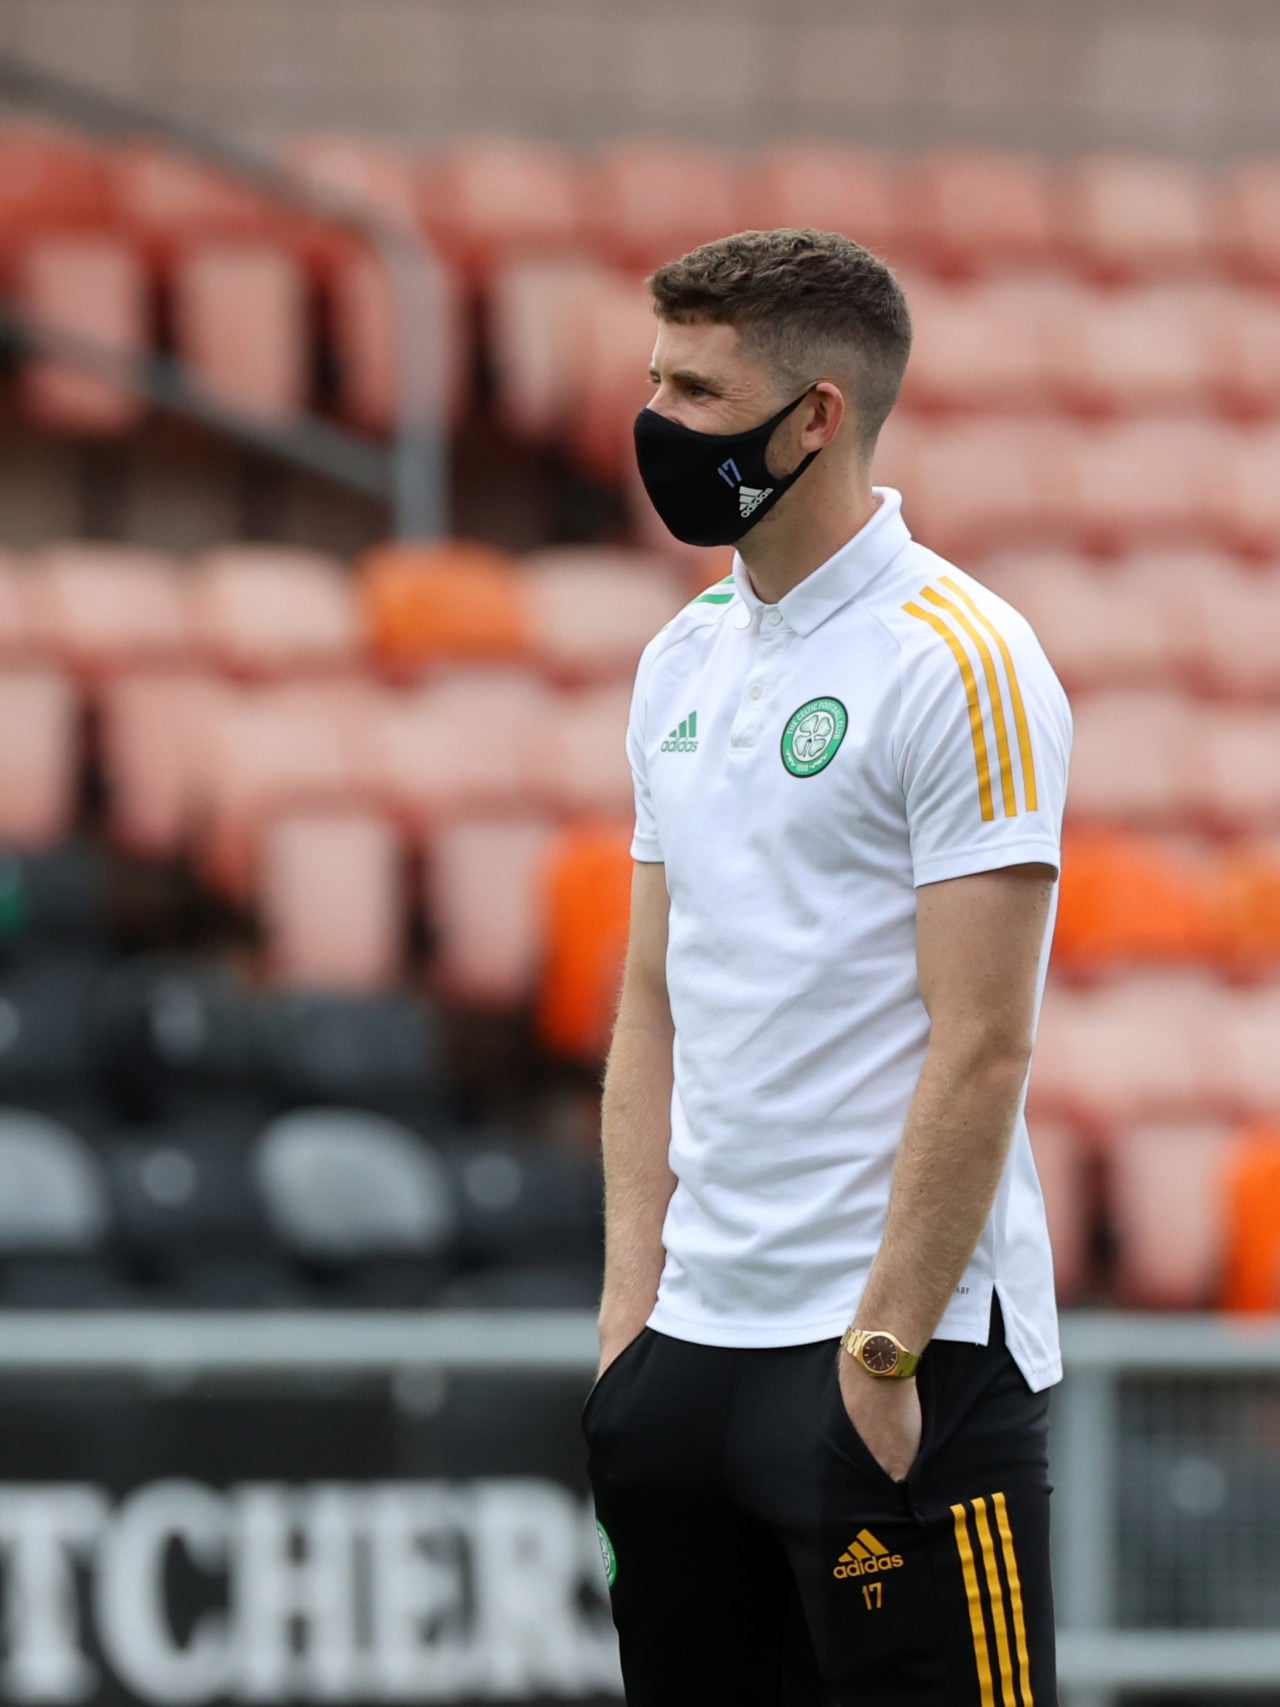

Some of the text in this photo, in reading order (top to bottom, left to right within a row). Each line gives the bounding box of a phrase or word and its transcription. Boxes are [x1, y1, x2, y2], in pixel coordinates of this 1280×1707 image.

[717, 457, 742, 488] 17
[660, 737, 699, 752] adidas
[833, 1554, 904, 1579] adidas
[862, 1582, 882, 1610] 17
